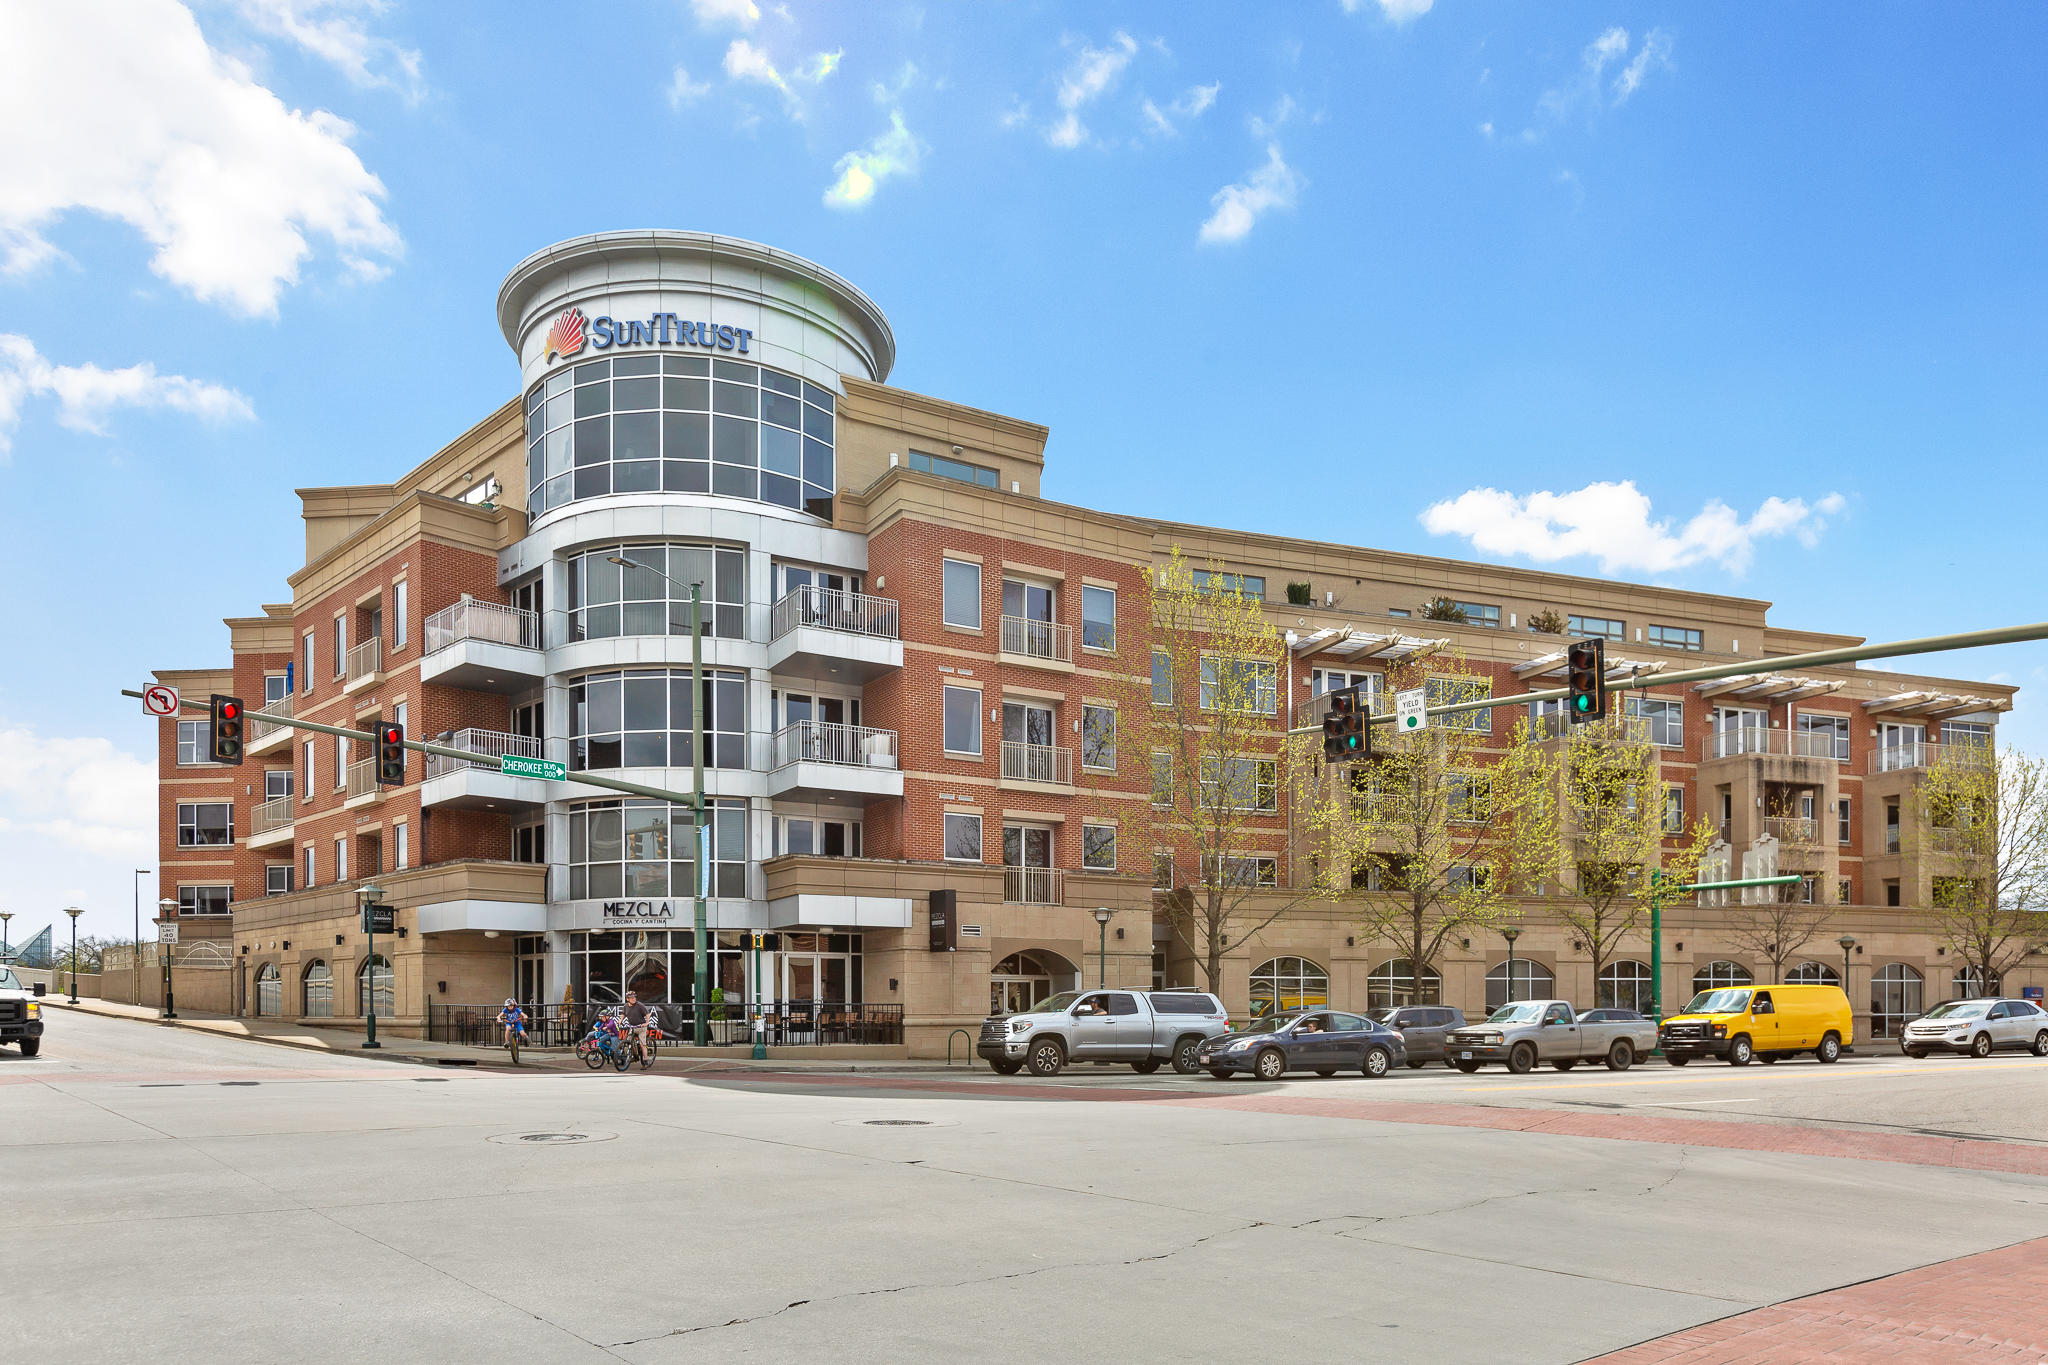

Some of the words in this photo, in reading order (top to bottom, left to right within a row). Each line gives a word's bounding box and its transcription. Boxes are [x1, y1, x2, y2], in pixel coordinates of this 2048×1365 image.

[1403, 699, 1418, 708] YIELD
[503, 759, 543, 774] CHEROKEE
[543, 762, 557, 771] BLVD
[603, 901, 672, 917] MEZCLA
